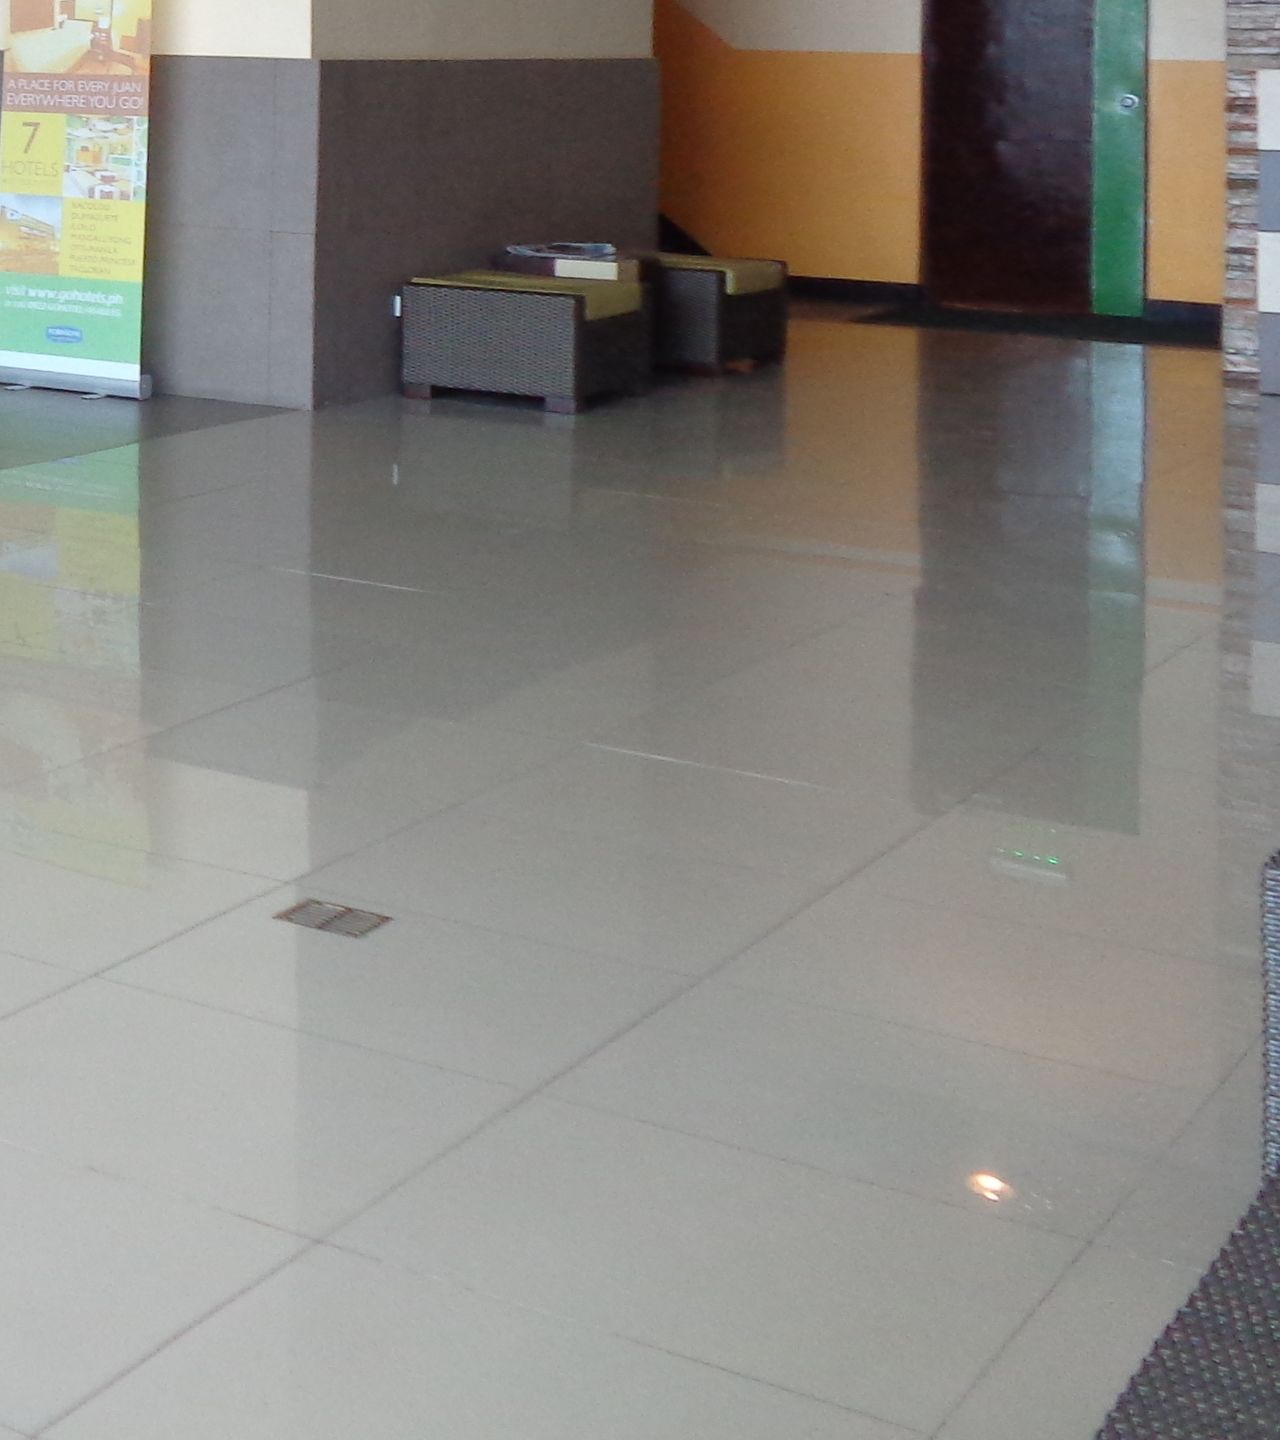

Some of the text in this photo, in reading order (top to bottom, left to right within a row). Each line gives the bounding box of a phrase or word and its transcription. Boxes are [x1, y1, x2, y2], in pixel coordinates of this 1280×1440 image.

[8, 79, 142, 93] A PLACE FOR EVERY JUAN
[6, 92, 87, 108] EVERYWHERE
[88, 95, 117, 109] YOU
[22, 121, 41, 154] 7
[0, 160, 59, 178] HOTELS
